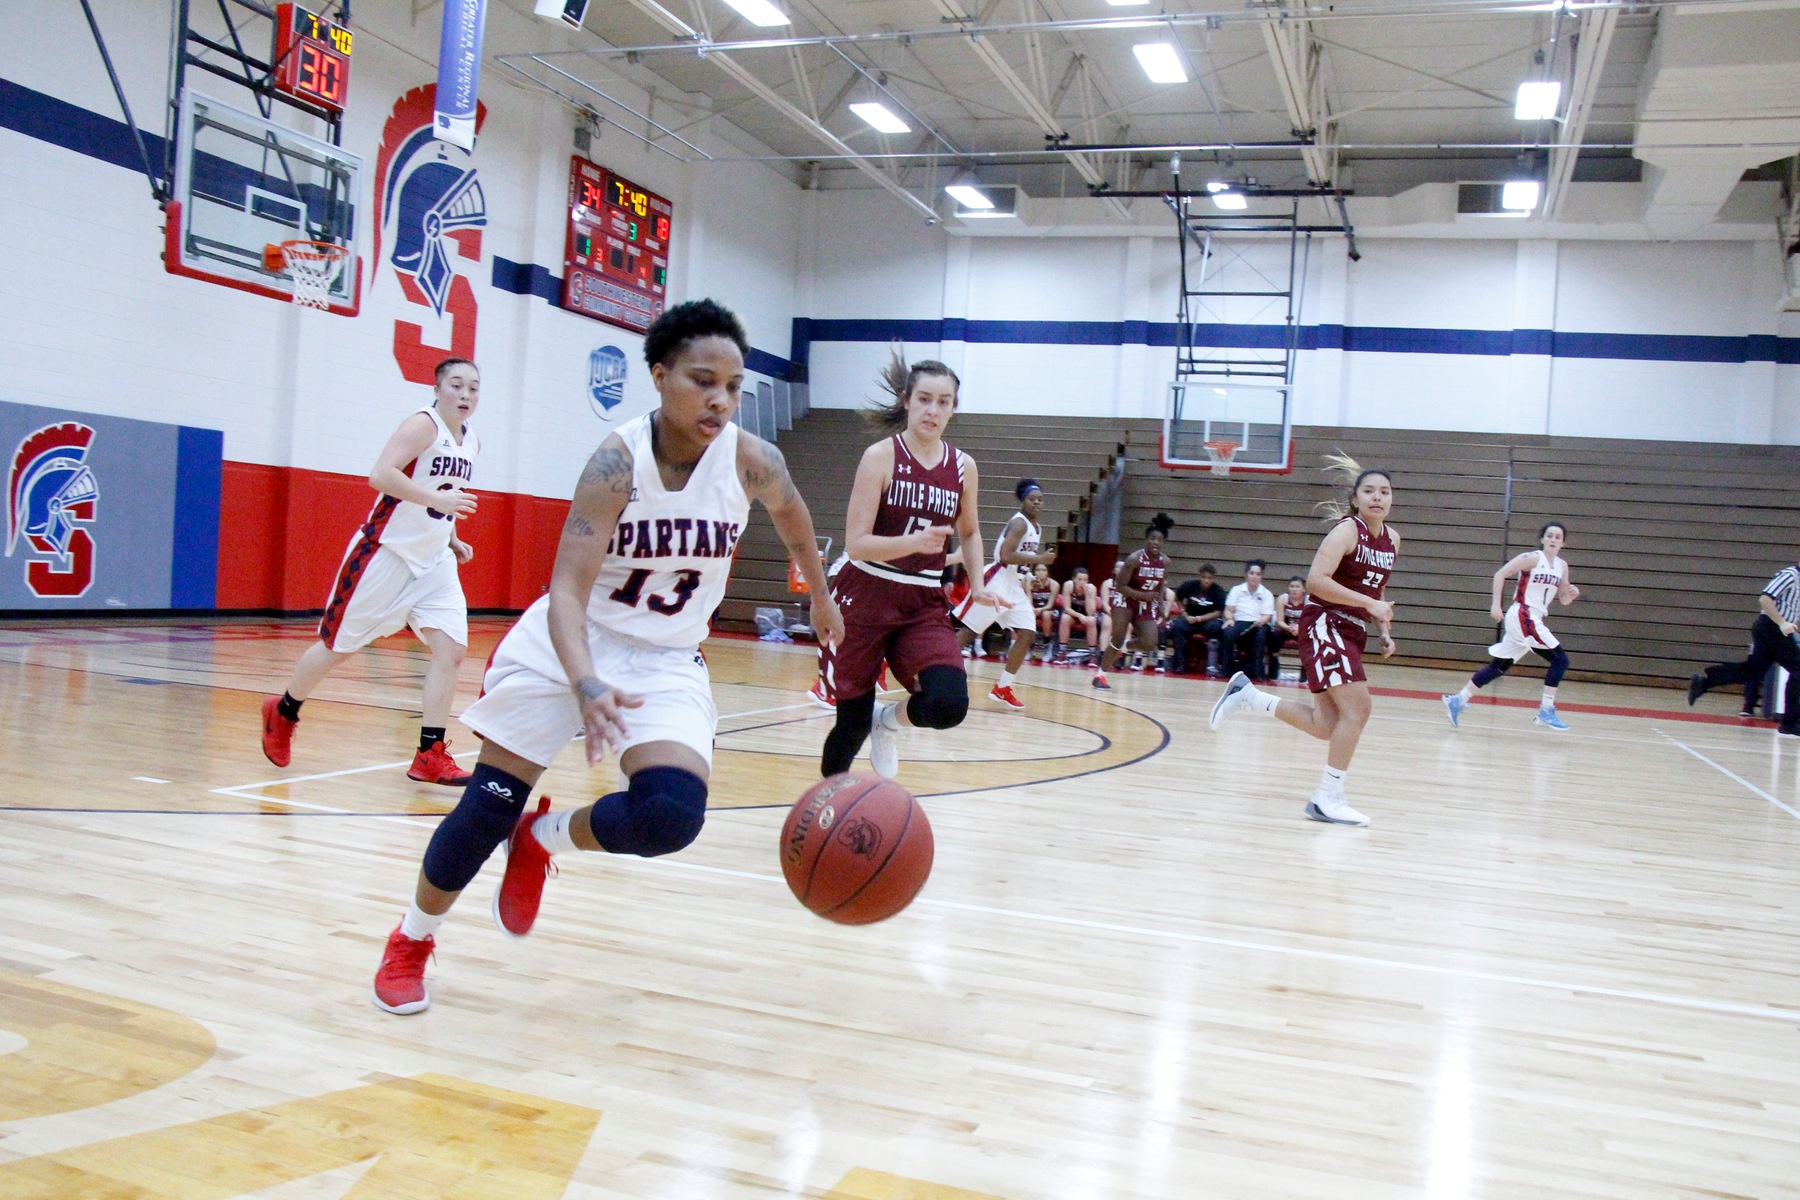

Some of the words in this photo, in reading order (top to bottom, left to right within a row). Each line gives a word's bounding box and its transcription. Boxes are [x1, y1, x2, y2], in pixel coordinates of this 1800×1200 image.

[299, 44, 340, 101] 30
[582, 181, 602, 210] 34
[615, 181, 648, 217] 7:40
[628, 221, 638, 241] 3
[887, 479, 925, 509] LITTLE
[607, 510, 739, 559] PARTANS
[609, 568, 702, 616] 13
[1361, 570, 1384, 589] 23
